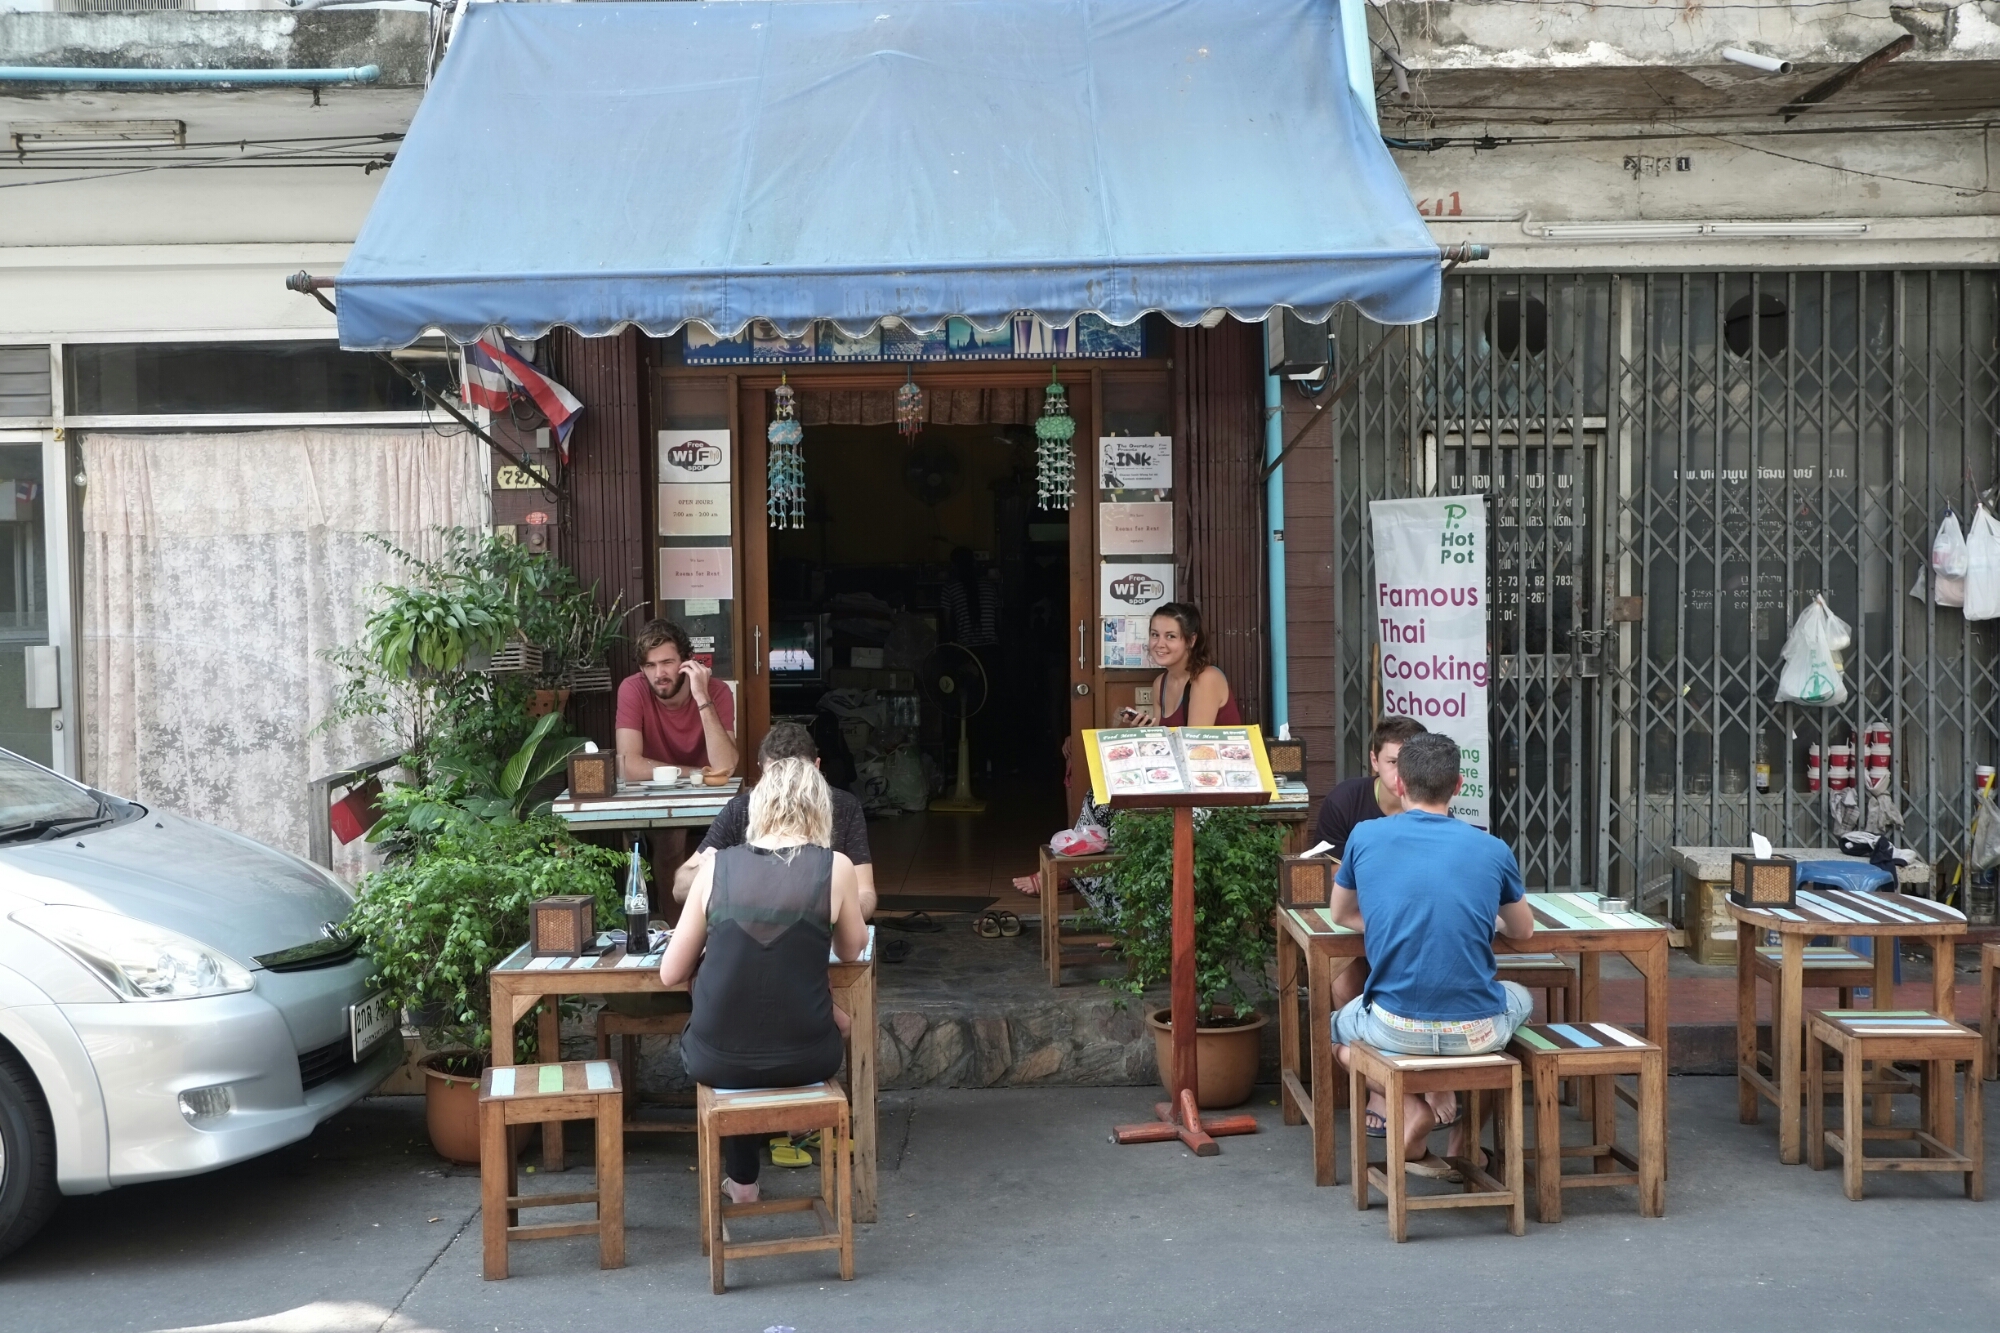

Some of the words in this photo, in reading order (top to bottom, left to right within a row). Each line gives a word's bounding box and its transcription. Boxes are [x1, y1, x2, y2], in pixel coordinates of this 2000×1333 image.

[53, 427, 65, 442] 2
[1116, 452, 1151, 467] INK
[1441, 532, 1474, 547] Hot
[1441, 550, 1474, 564] Pot
[1379, 583, 1478, 607] Famous
[1380, 618, 1425, 643] Thai
[1384, 653, 1488, 687] Cooking
[1386, 689, 1465, 717] School
[1459, 768, 1479, 779] ere
[1458, 783, 1484, 798] 295
